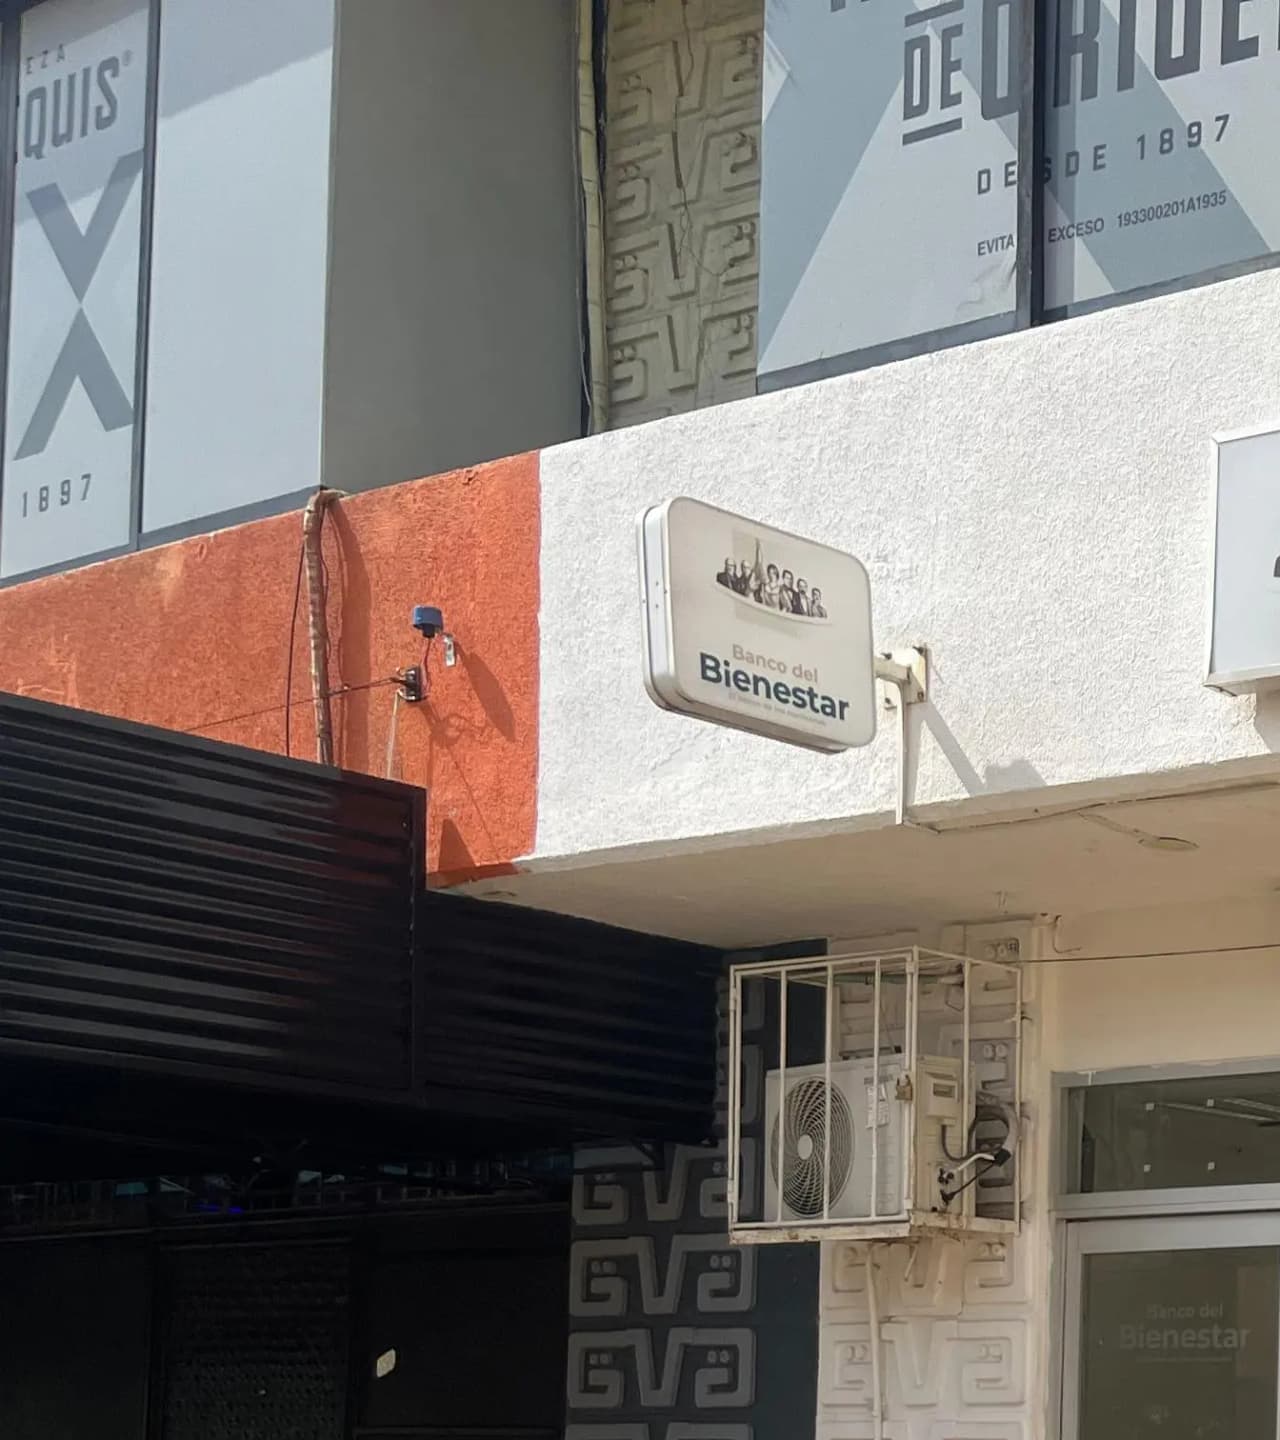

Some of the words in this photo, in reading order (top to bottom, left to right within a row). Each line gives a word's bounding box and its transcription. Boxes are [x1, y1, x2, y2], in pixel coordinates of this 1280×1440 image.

[902, 22, 964, 121] DE
[1136, 114, 1230, 160] 1897
[977, 233, 1016, 257] EVITA
[1048, 217, 1105, 243] EXCESO
[22, 473, 92, 518] 1897
[700, 652, 850, 721] Bienestar
[732, 644, 788, 675] Banco
[792, 664, 819, 685] del
[1119, 1321, 1251, 1350] Bienestar
